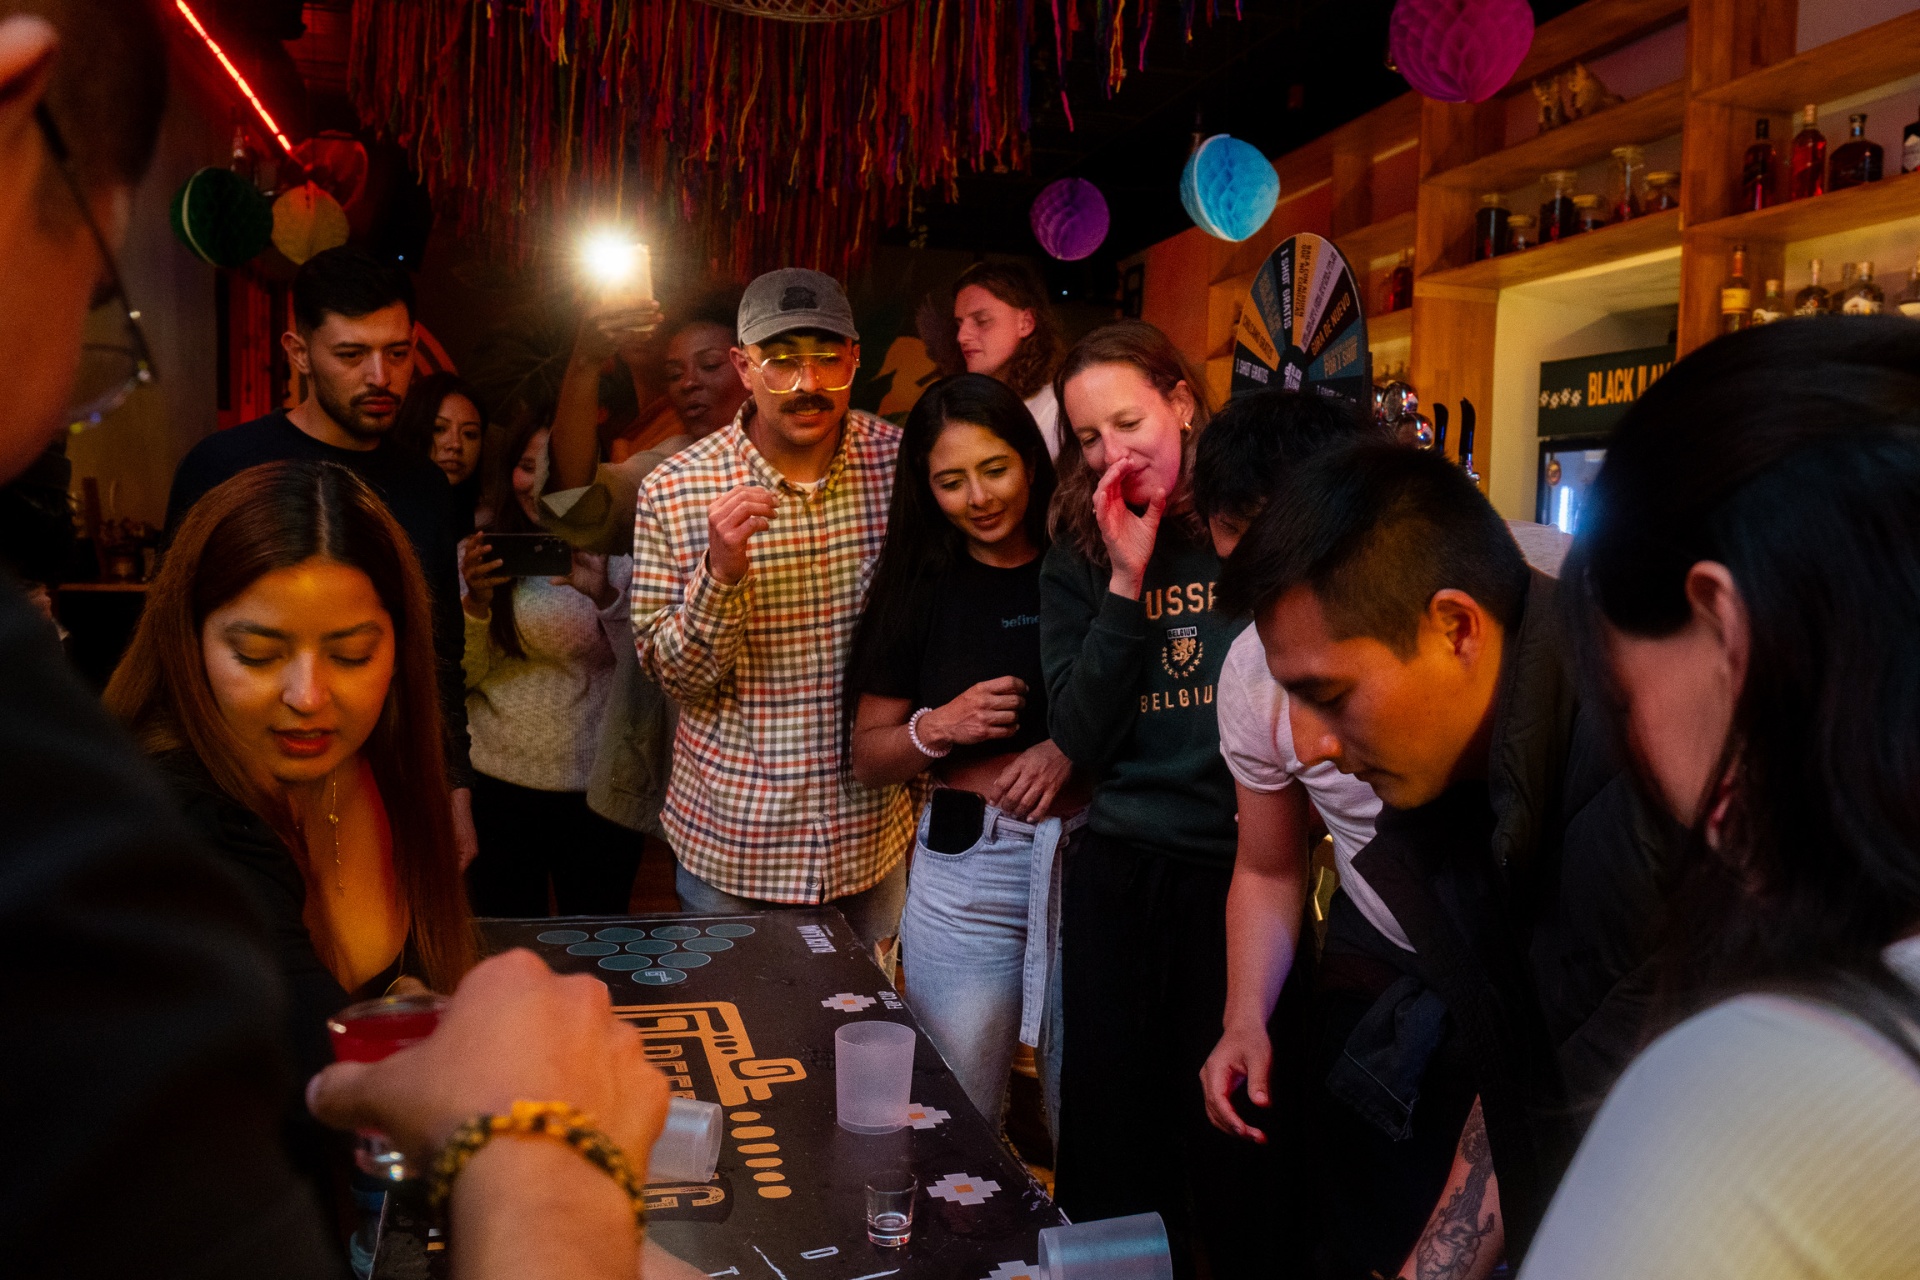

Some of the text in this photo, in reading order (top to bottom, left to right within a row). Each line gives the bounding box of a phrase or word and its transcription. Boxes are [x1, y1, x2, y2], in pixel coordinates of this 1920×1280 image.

[1280, 248, 1293, 330] 1 SHOT GRATIS
[1330, 292, 1351, 326] NUEVO
[1588, 368, 1634, 406] BLACK
[1167, 628, 1196, 638] BELGIUM
[1140, 684, 1213, 713] BELGIU
